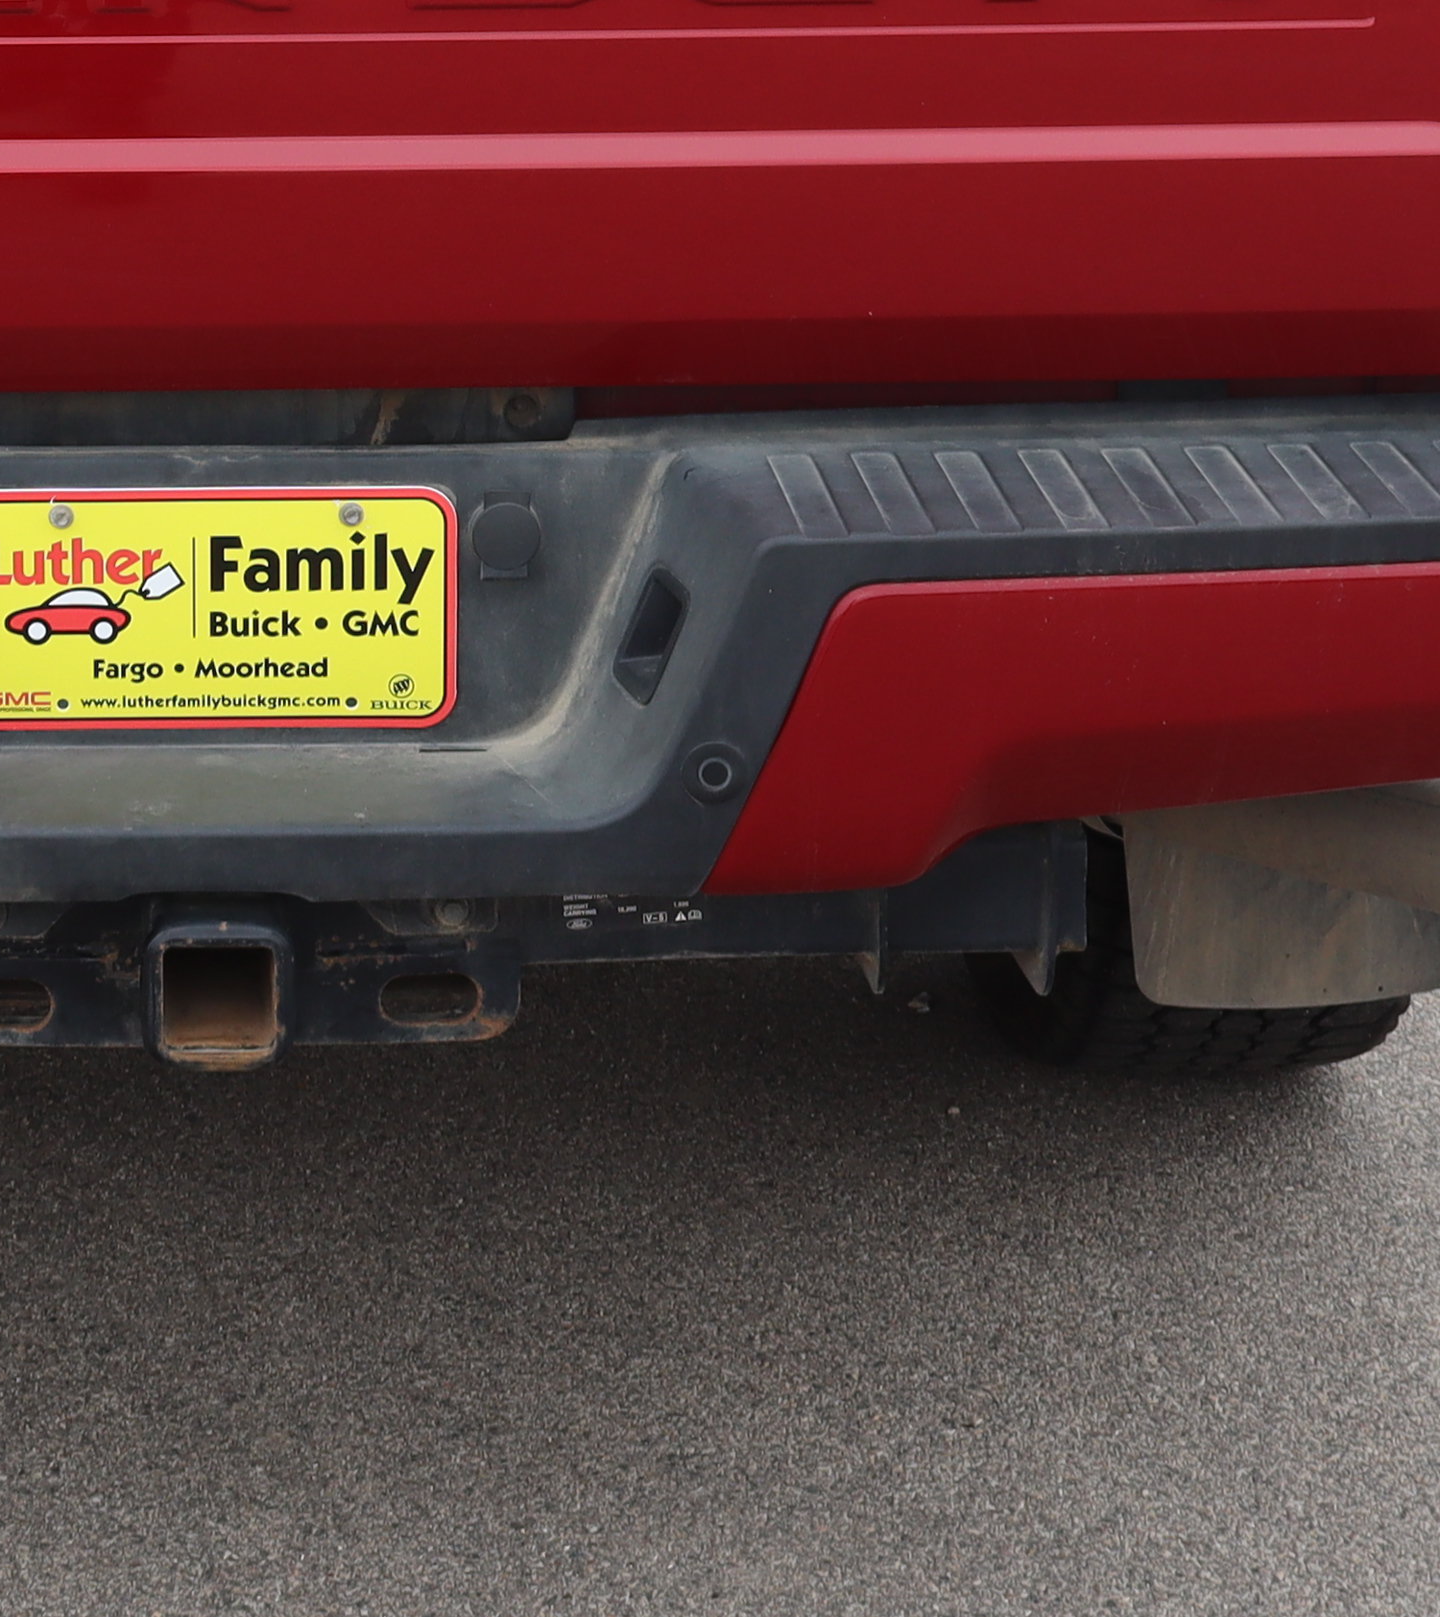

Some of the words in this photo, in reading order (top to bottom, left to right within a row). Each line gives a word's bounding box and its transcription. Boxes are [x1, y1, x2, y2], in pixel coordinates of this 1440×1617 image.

[209, 531, 435, 605] Family
[209, 610, 302, 637] Buick
[342, 610, 419, 637] GMC
[93, 659, 164, 684] Fargo
[194, 657, 329, 679] Moorhead
[80, 694, 341, 710] www.lutherfamilybuickgmc.com
[370, 699, 433, 711] BUICK
